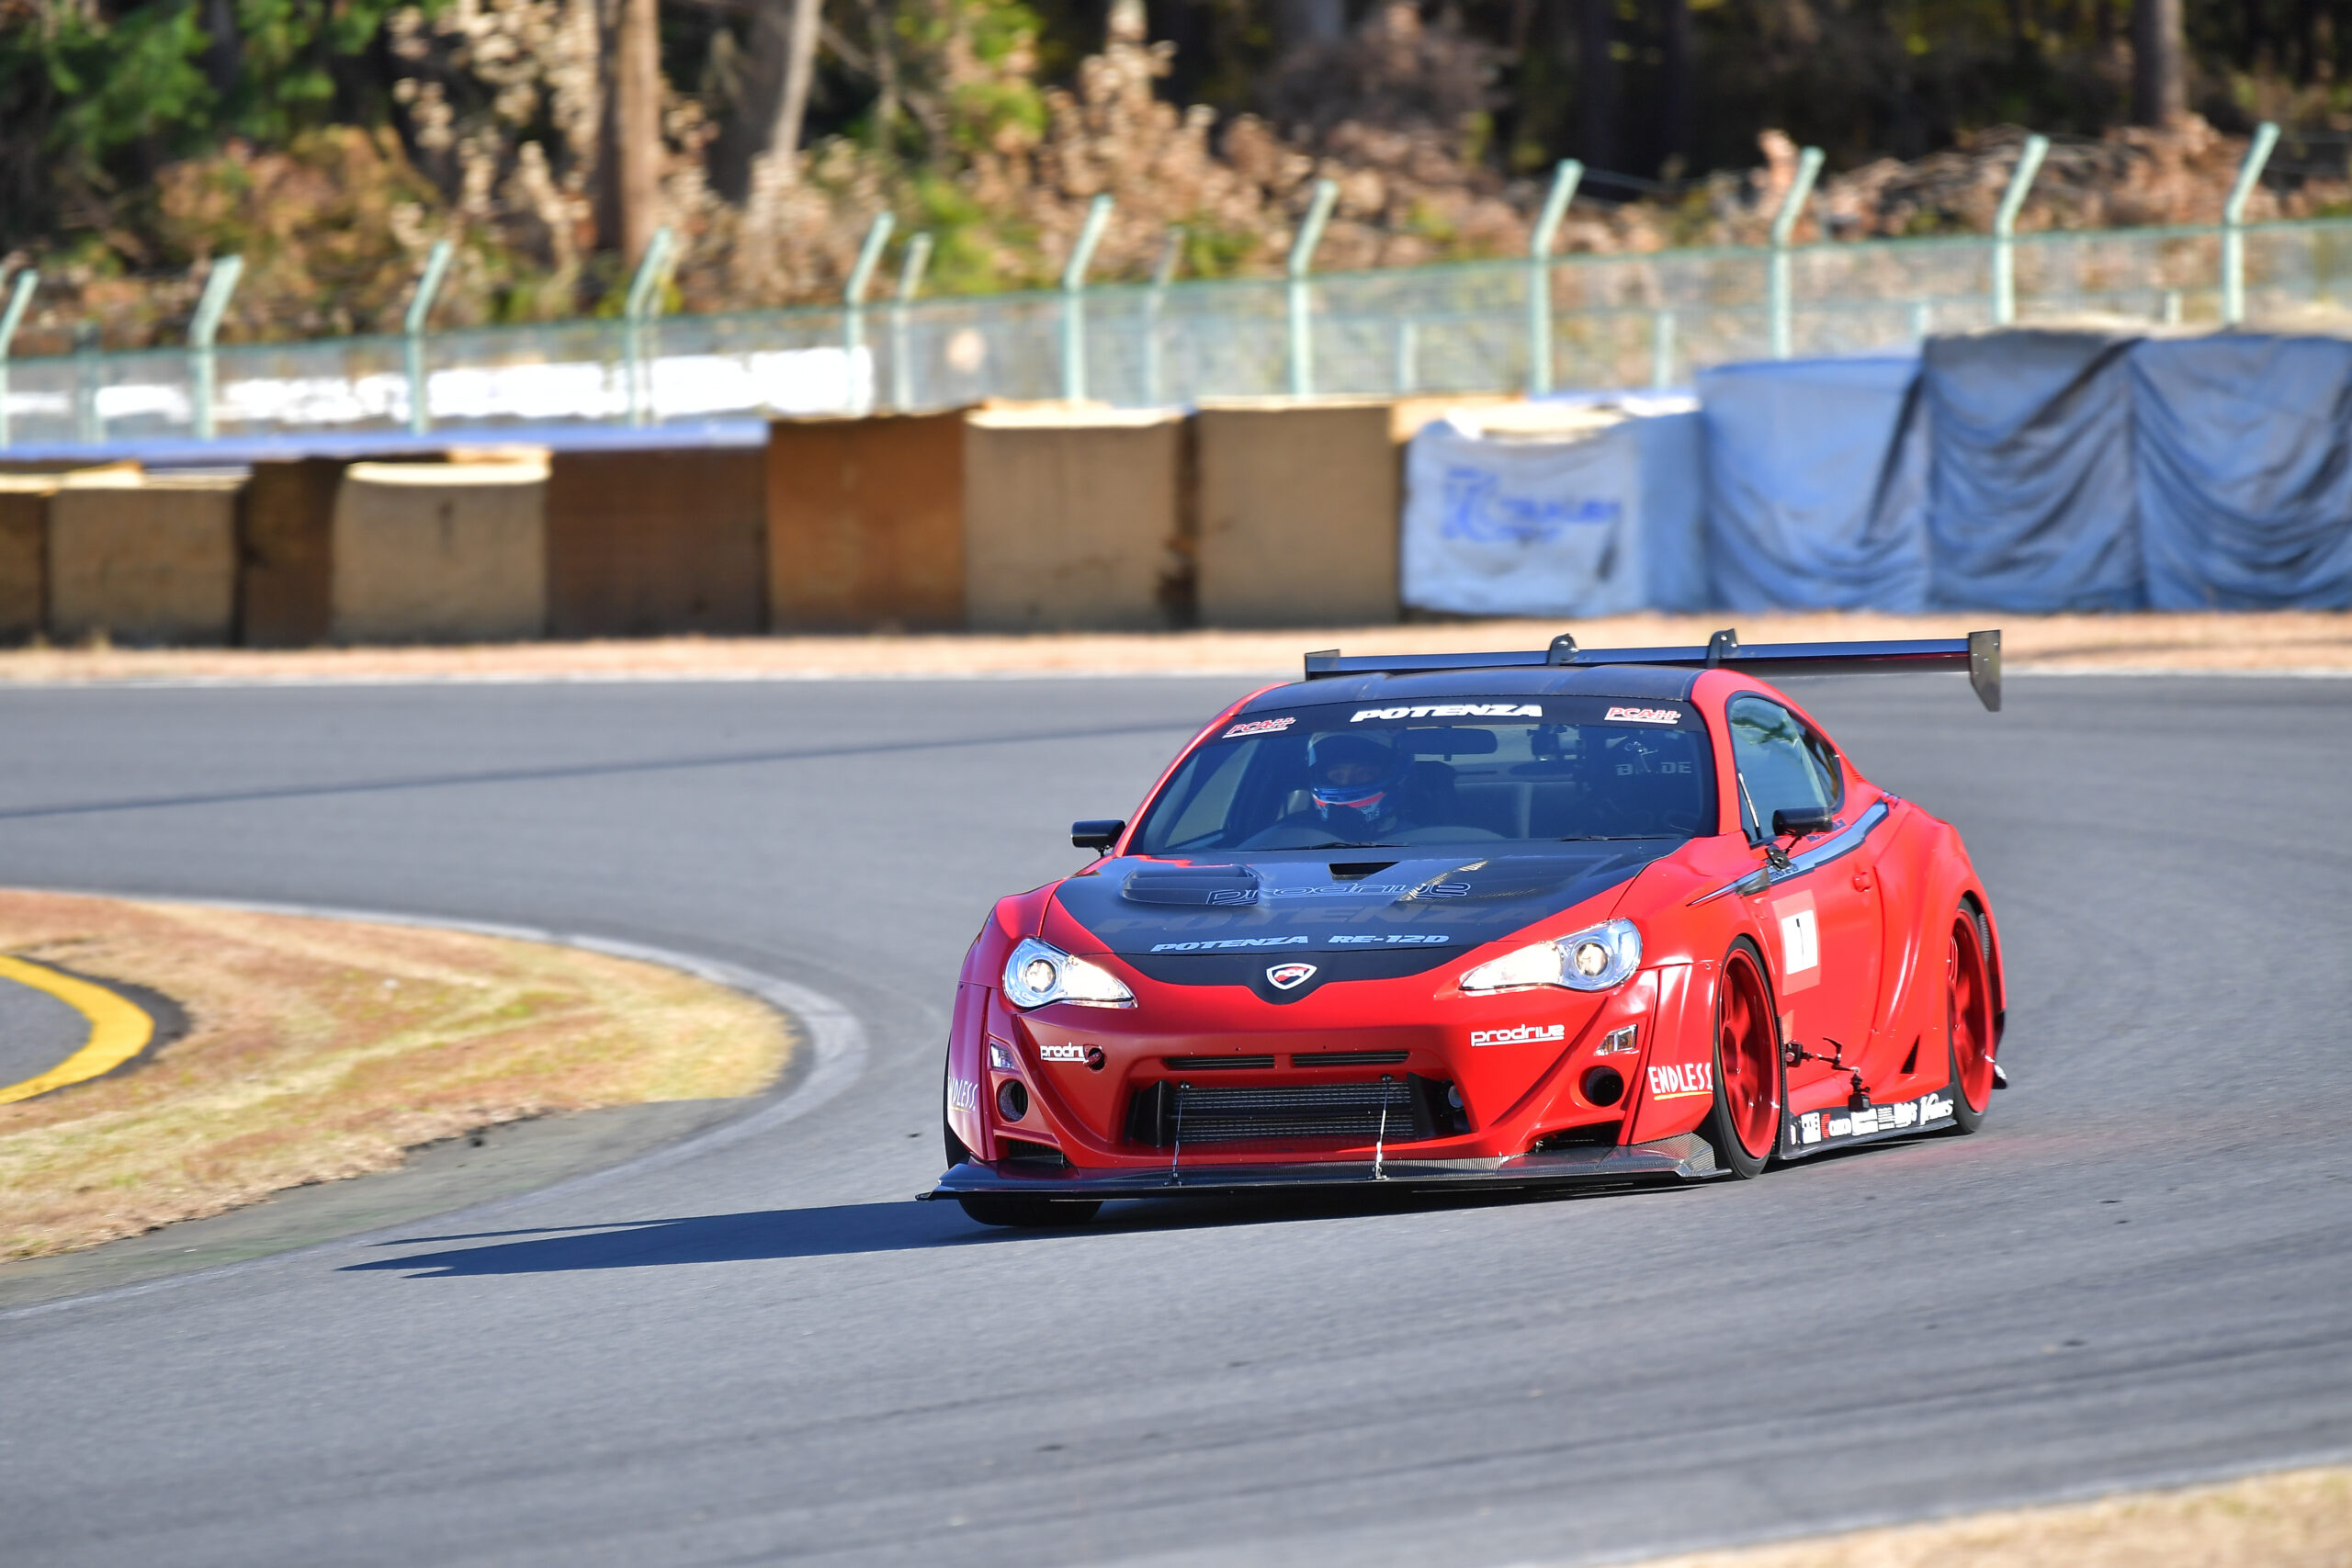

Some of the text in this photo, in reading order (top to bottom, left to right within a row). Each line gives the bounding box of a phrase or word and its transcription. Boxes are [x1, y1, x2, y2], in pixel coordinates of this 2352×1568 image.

[1350, 705, 1543, 722] POTENZA
[1616, 762, 1691, 775] BDE
[1150, 936, 1308, 952] POTENZA
[1471, 1024, 1565, 1046] prodrive
